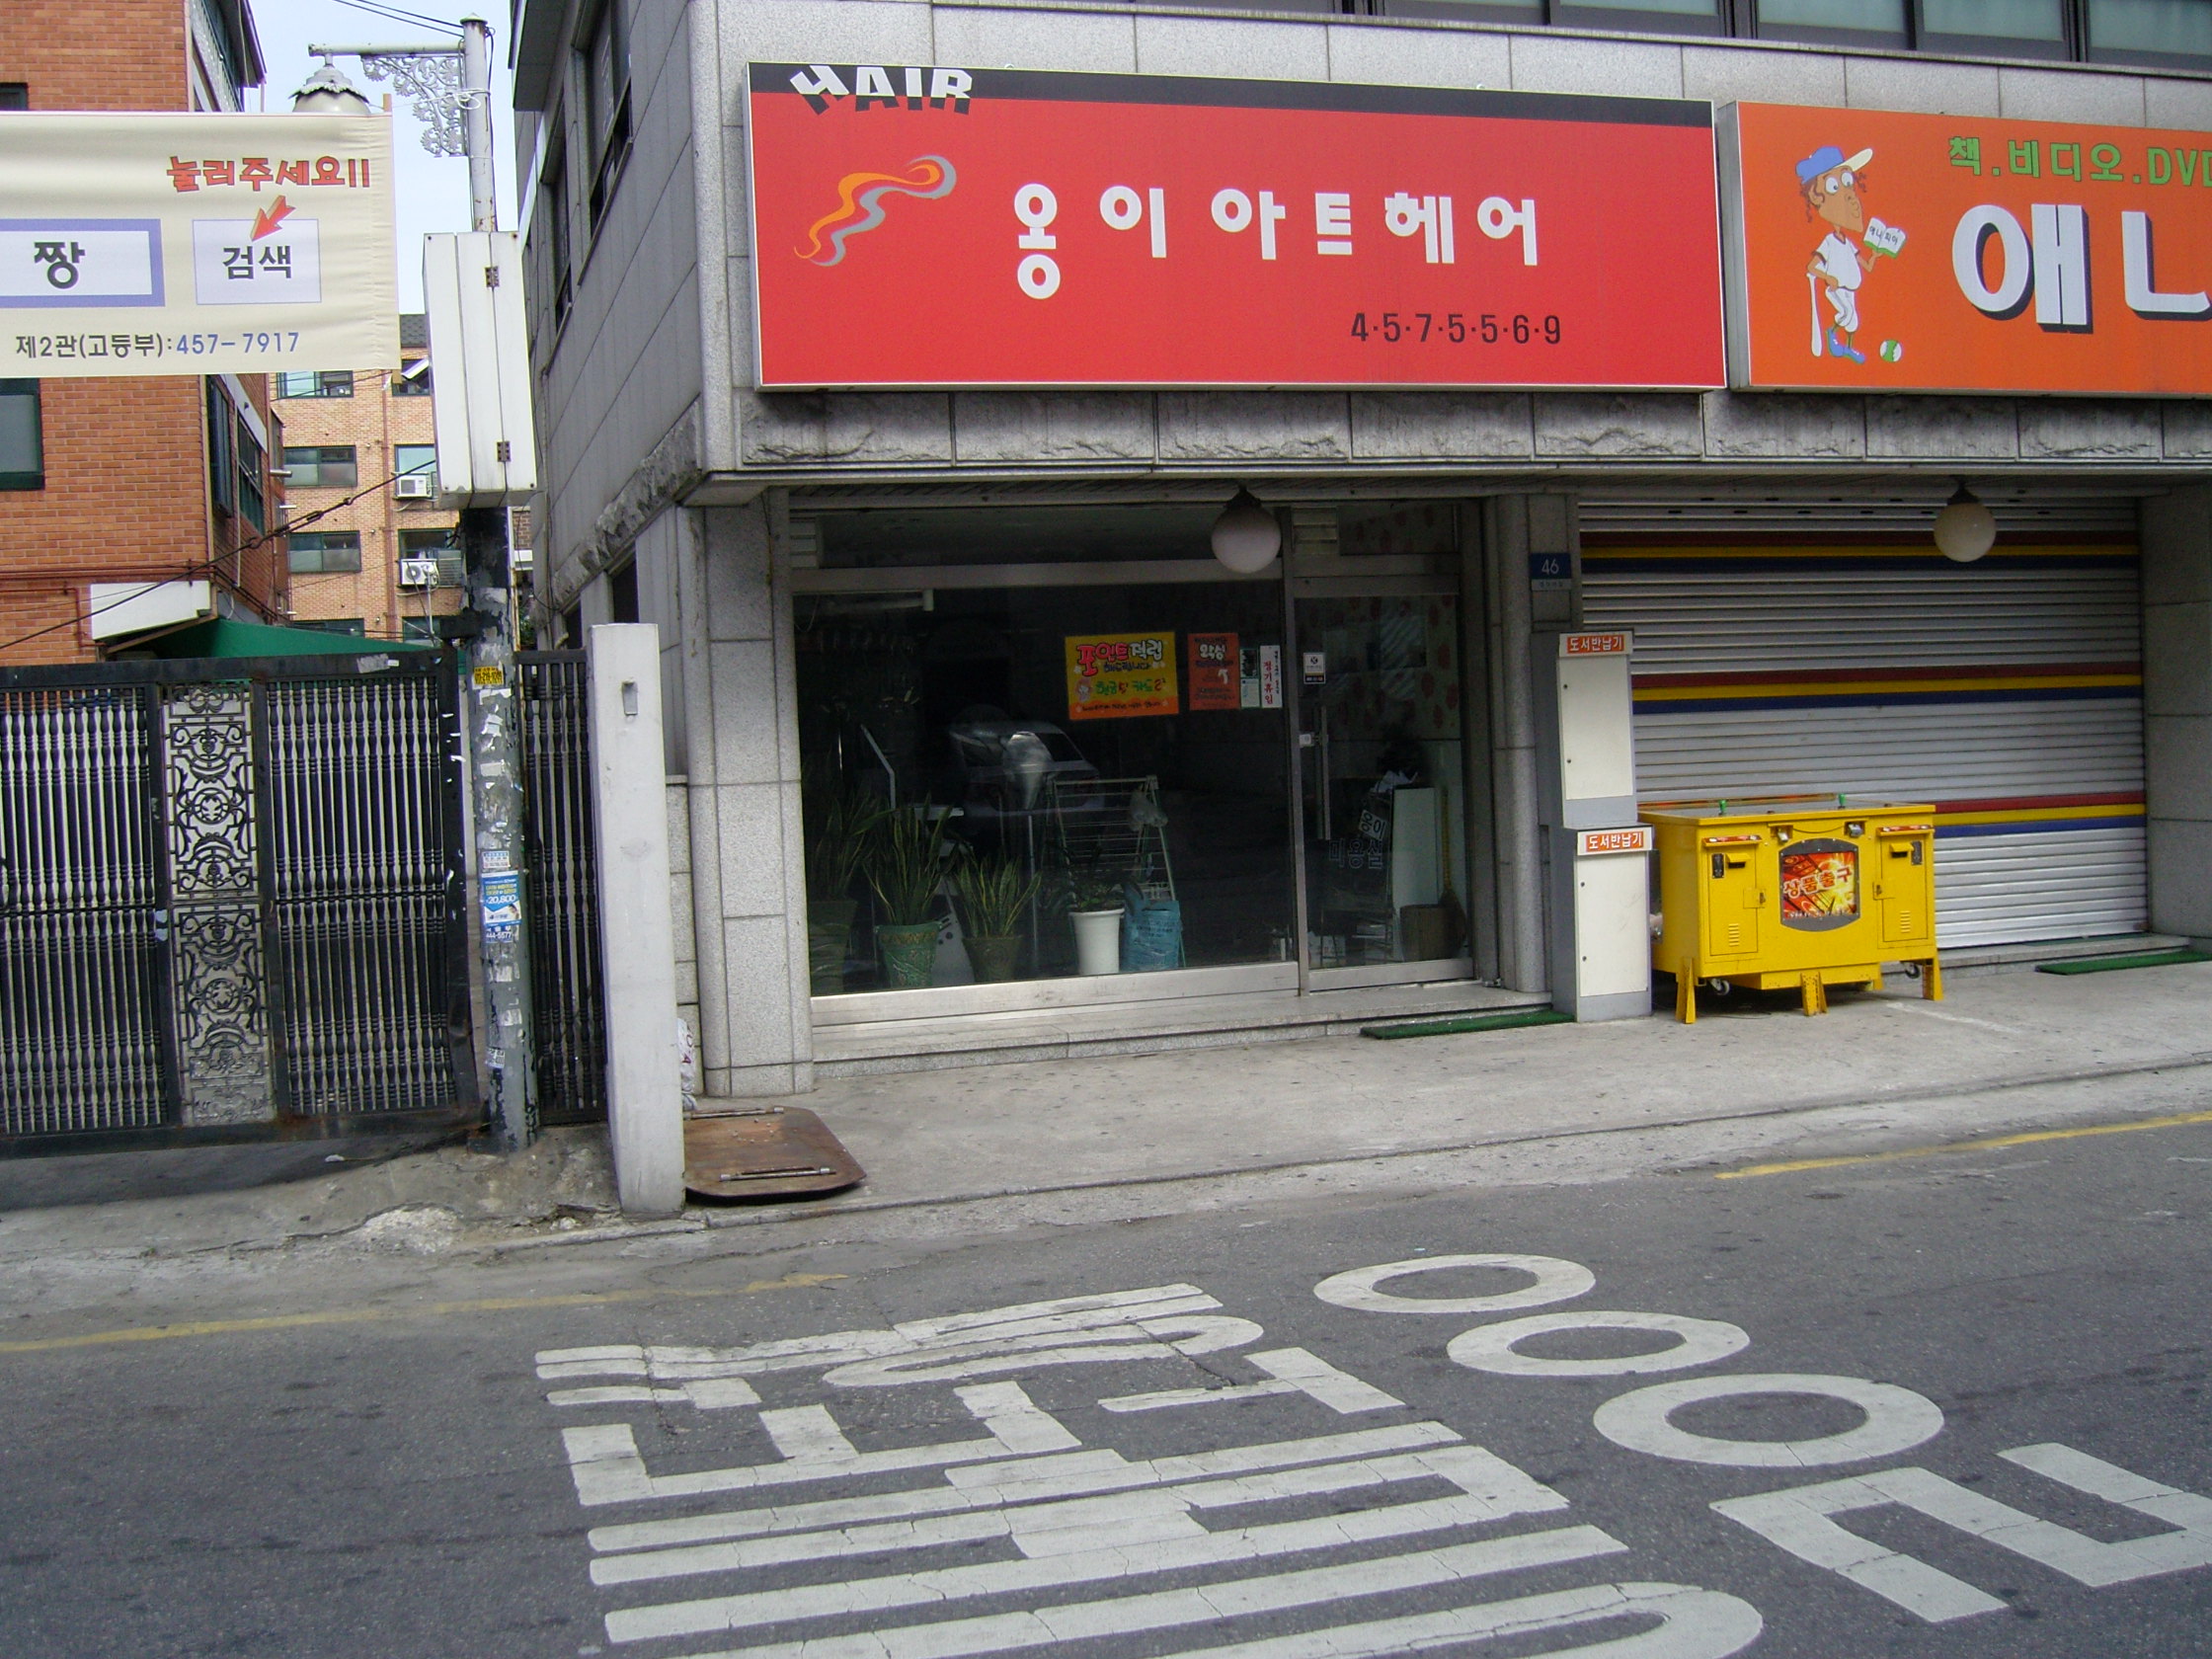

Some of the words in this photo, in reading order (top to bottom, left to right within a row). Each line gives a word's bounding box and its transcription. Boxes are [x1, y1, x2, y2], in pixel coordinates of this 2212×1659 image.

[790, 65, 973, 115] HAIR
[166, 156, 370, 193] 눌러주세요!!
[34, 241, 86, 289] 짱
[222, 245, 292, 279] 검색
[1541, 558, 1560, 575] 46
[1569, 636, 1622, 652] 도서반납기
[1361, 812, 1386, 839] 용이
[1588, 831, 1642, 849] 도서반납기
[1329, 837, 1383, 869] 미용실
[1783, 865, 1853, 899] 상품출구
